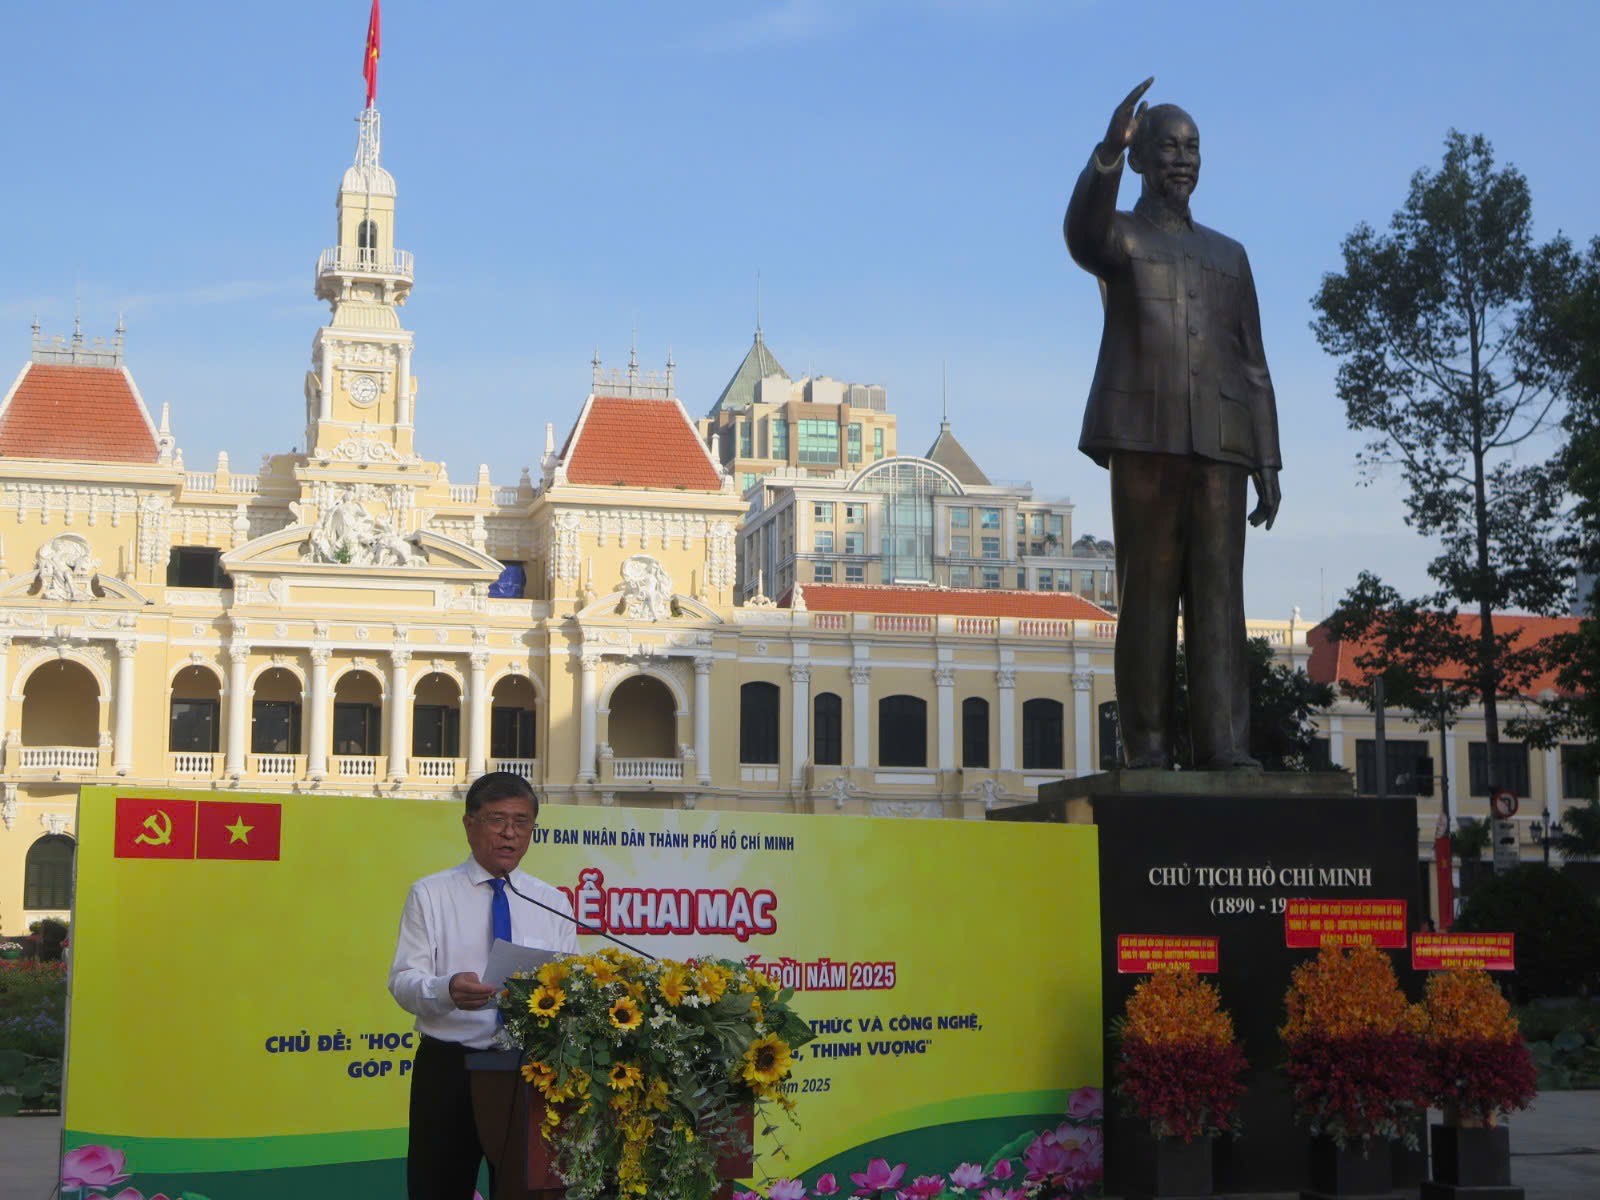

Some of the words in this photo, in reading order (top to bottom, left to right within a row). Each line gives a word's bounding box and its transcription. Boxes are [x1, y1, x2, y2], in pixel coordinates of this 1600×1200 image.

[553, 829, 579, 845] BAN
[583, 827, 617, 846] NHÂN
[621, 828, 645, 846] DÂN
[649, 828, 689, 848] THÀNH
[693, 829, 718, 849] PHỐ
[721, 830, 737, 849] HỒ
[741, 832, 761, 850] CHÍ
[764, 836, 794, 850] MINH
[1148, 863, 1191, 886] CHỦ
[1196, 867, 1242, 889] TỊCH
[1248, 861, 1276, 887] HỒ
[1279, 864, 1314, 887] CHÍ
[1318, 867, 1373, 887] MINH
[607, 888, 695, 935] KHAI
[696, 888, 778, 943] MẠC
[1210, 897, 1255, 916] (1890
[805, 957, 847, 991] NĂM
[850, 962, 895, 989] 2025
[809, 1016, 853, 1034] THỨC
[858, 1015, 884, 1032] VÀ
[889, 1014, 933, 1031] CÔNG
[937, 1012, 983, 1031] NGHỆ,
[265, 1030, 311, 1053] CHỦ
[317, 1029, 352, 1051] ĐỀ:
[360, 1033, 413, 1052] "HỌC
[810, 1043, 862, 1060] THỊNH
[348, 1058, 393, 1078] GÓP
[801, 1078, 831, 1093] 2025
